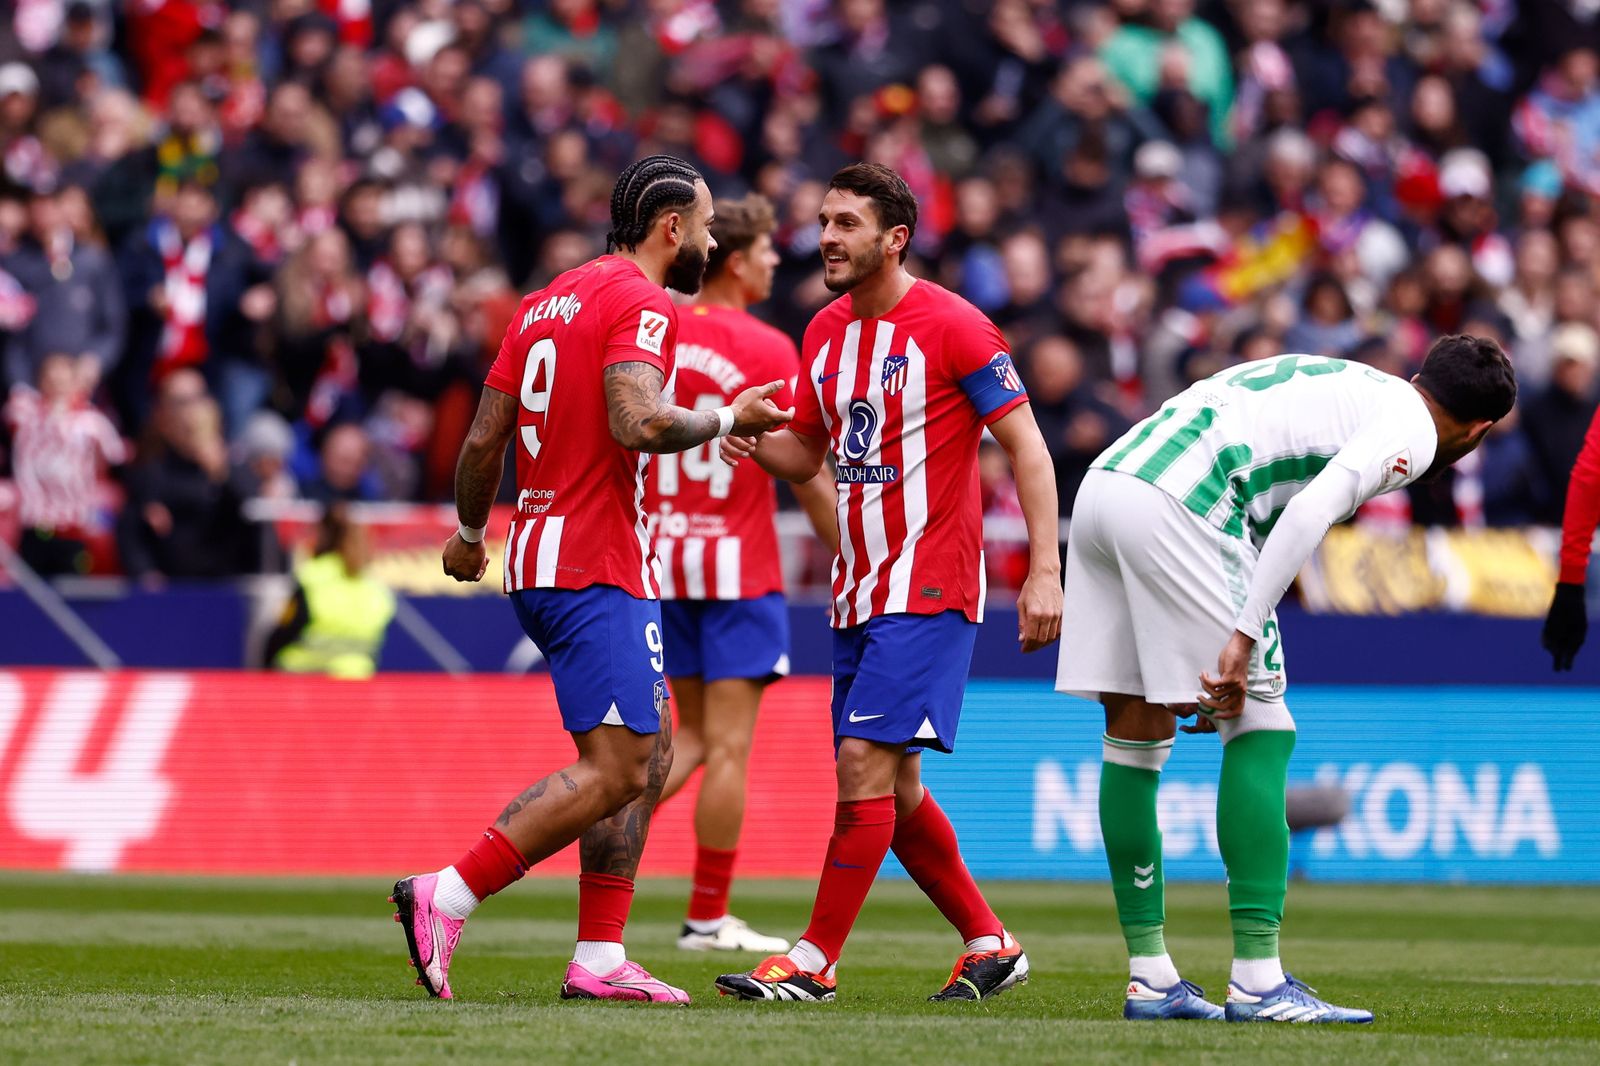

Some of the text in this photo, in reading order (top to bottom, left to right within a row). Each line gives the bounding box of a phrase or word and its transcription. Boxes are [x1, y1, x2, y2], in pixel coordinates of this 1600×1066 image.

[520, 338, 557, 460] 9
[869, 466, 895, 482] AIR
[645, 621, 664, 673] 9
[1262, 619, 1282, 672] 2
[1311, 759, 1560, 860] KONA
